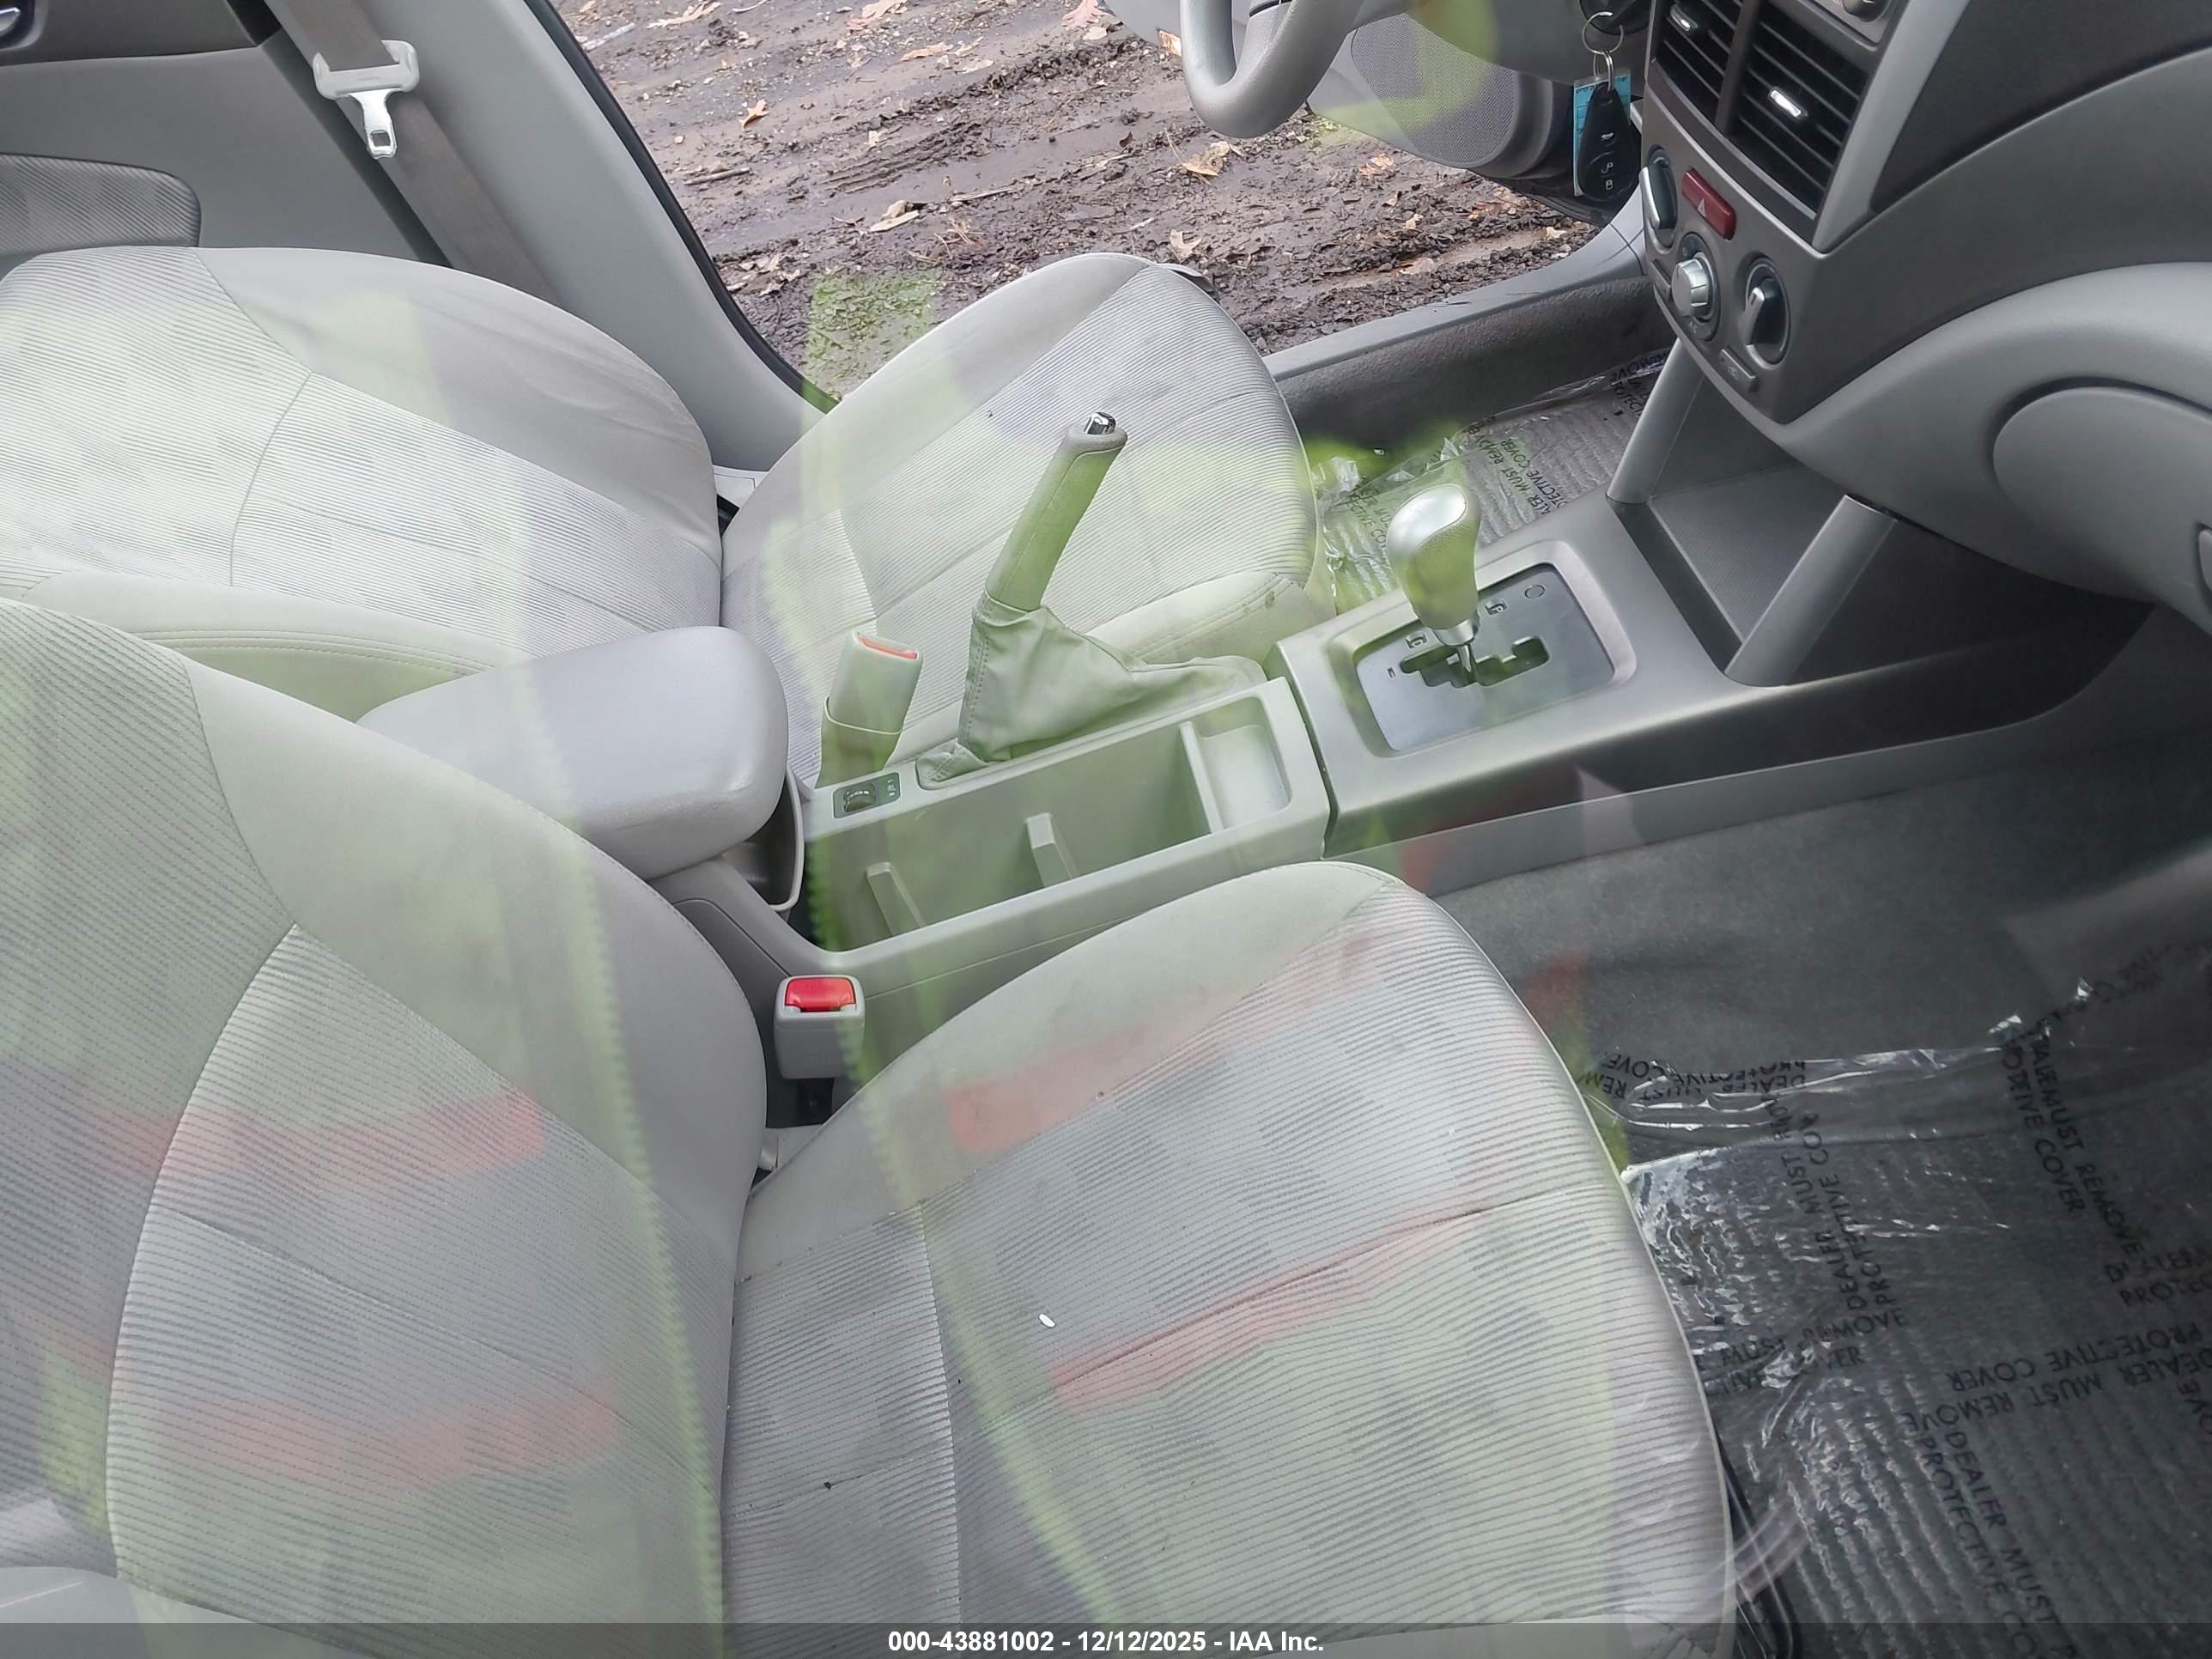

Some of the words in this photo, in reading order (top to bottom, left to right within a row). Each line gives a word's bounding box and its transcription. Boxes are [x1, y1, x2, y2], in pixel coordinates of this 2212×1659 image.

[1500, 438, 1531, 469] COVER
[1500, 468, 1532, 495] MUST
[1780, 1154, 1825, 1214] MUST
[2034, 1137, 2086, 1212] COVER
[2044, 1321, 2203, 1373] PROTECTIVE
[1945, 1357, 2036, 1392] COVER
[2026, 1376, 2103, 1408] MUST
[1901, 1390, 2015, 1437] REMOVE
[1917, 1435, 2008, 1594] PROTECTIVE
[1943, 1430, 2008, 1529] DEALER
[2000, 1547, 2061, 1626] MUST
